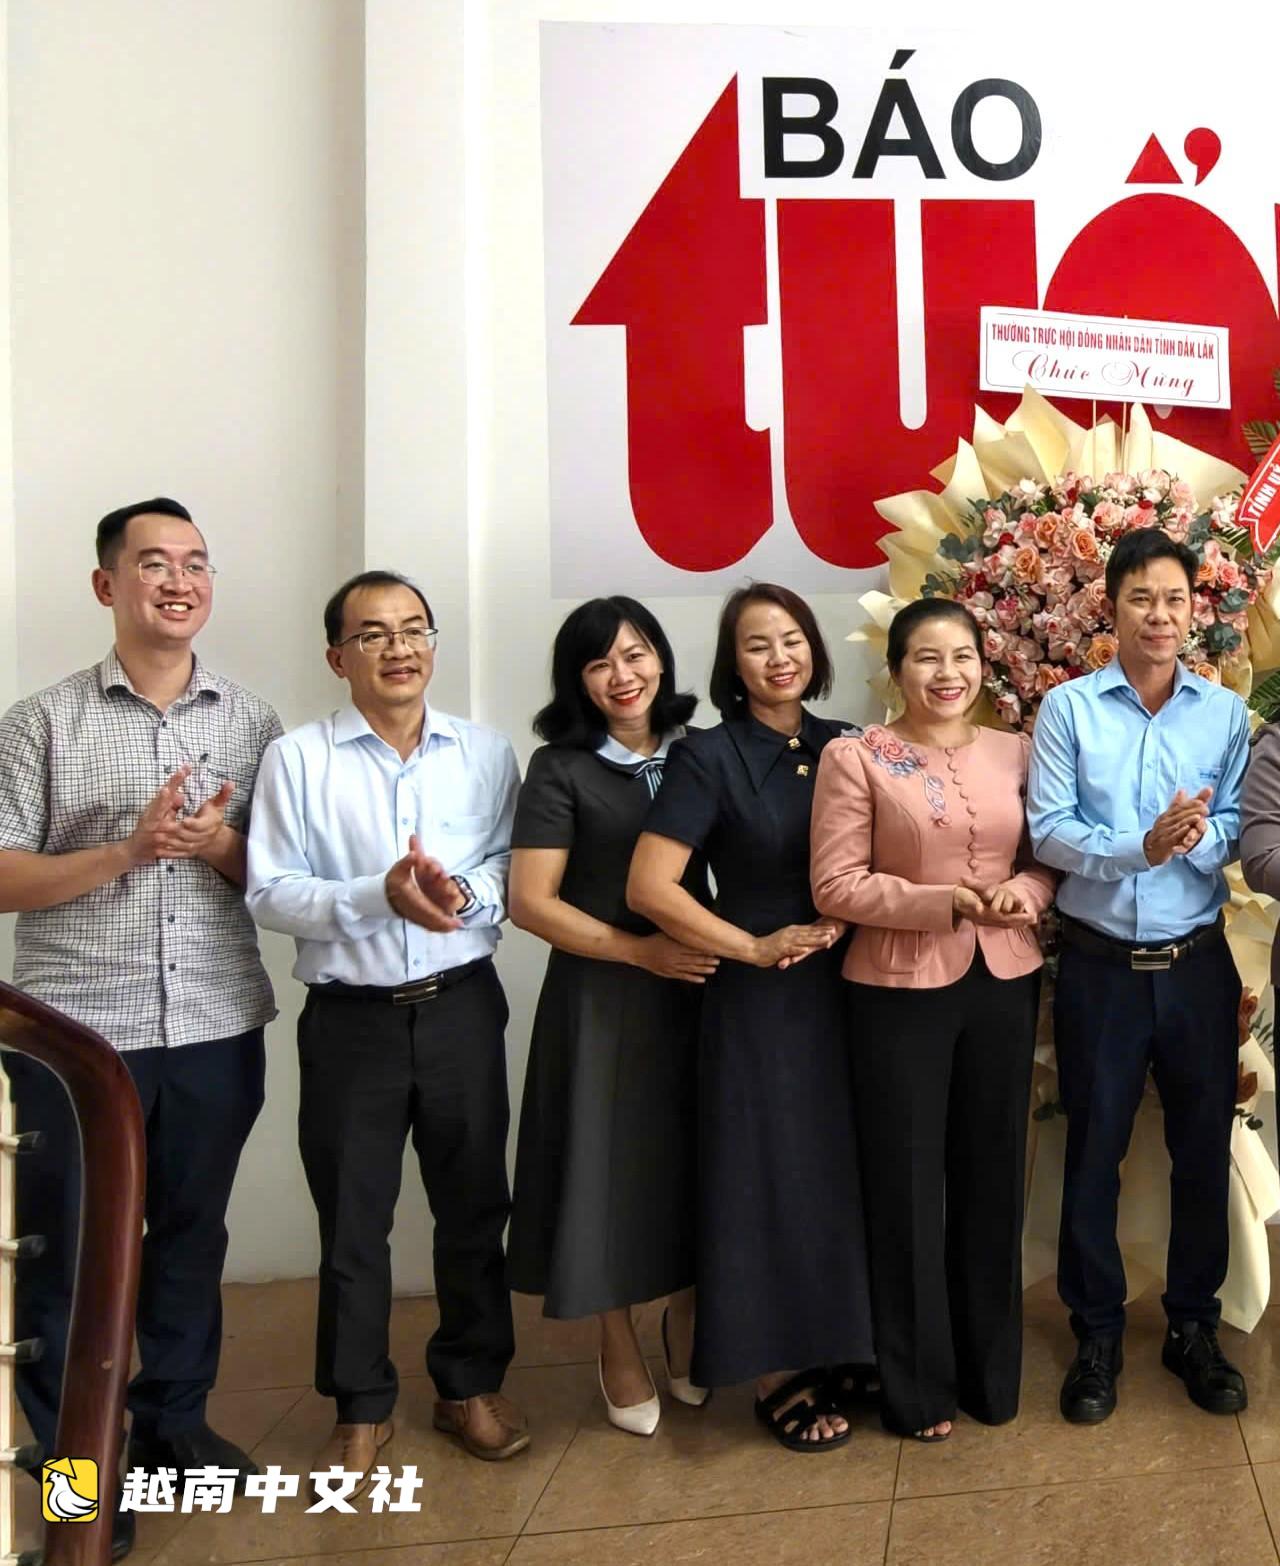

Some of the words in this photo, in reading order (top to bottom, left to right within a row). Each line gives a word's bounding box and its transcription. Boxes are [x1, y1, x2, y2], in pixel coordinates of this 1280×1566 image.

[762, 49, 1042, 181] BÁO
[1059, 326, 1075, 351] HỘI
[1105, 331, 1132, 352] NHÂN
[1133, 332, 1152, 354] DÂN
[1154, 333, 1176, 356] TỈNH
[1012, 350, 1089, 383] Chúc
